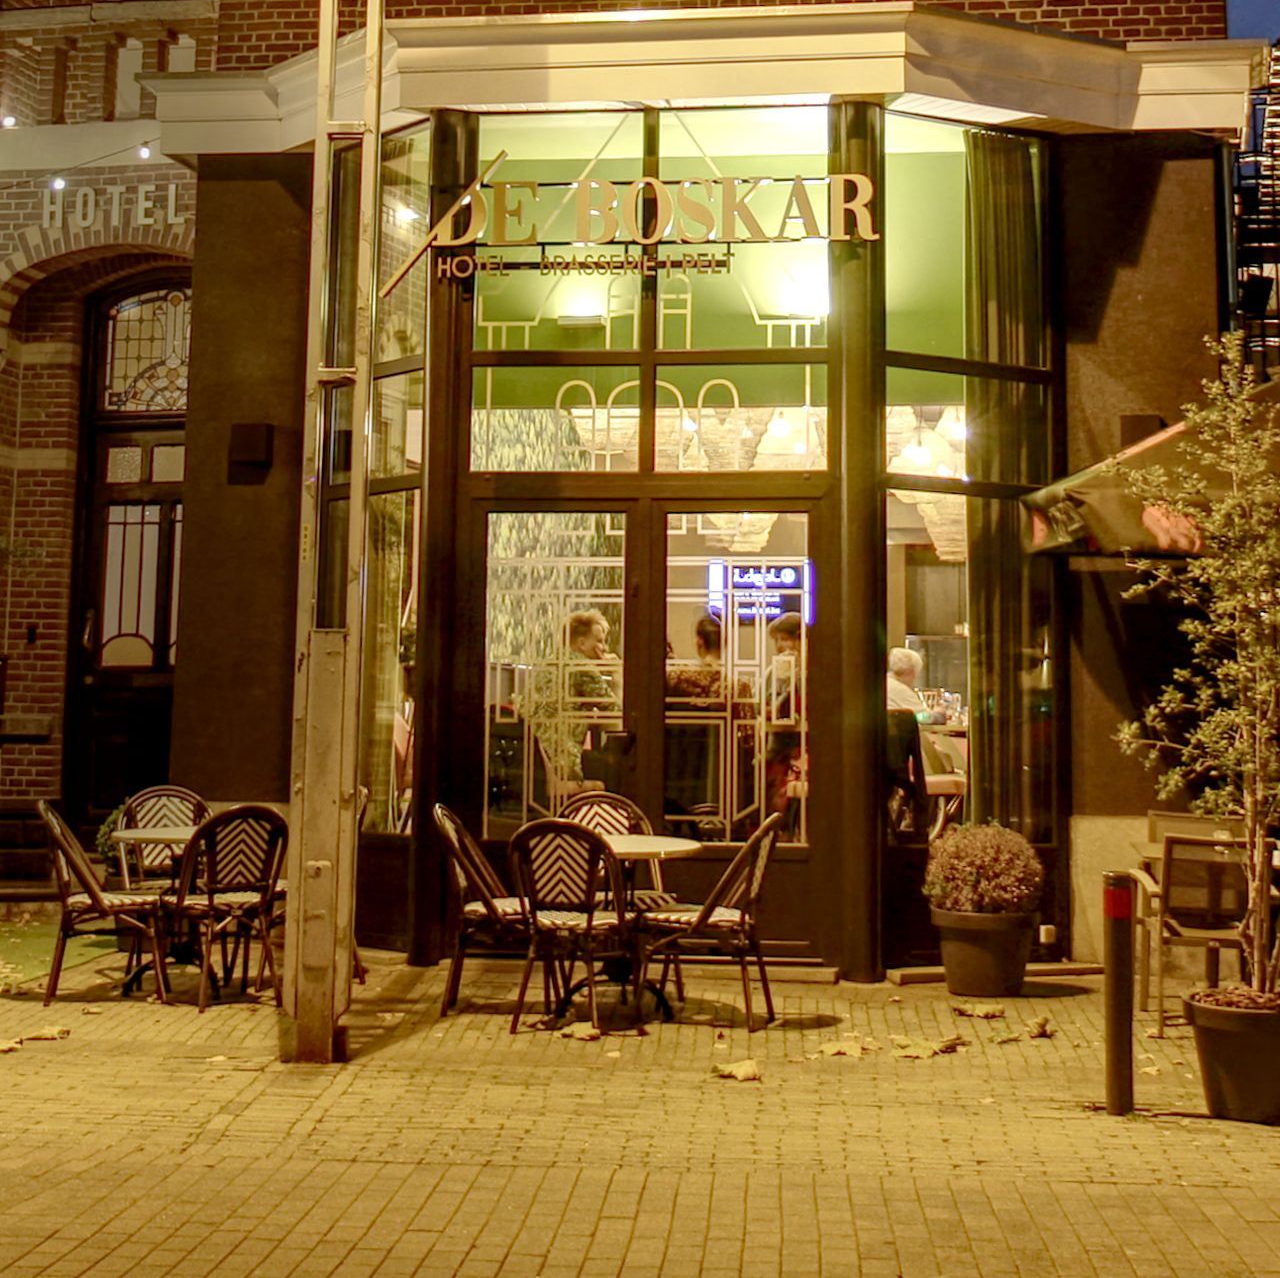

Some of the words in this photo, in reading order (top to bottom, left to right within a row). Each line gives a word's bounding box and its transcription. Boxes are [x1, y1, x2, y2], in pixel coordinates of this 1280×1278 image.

[42, 183, 185, 228] HOTEL
[574, 173, 880, 245] BOSKAR
[437, 255, 510, 278] HOTEL
[539, 252, 657, 278] BRASSERIE
[682, 252, 735, 275] PELT
